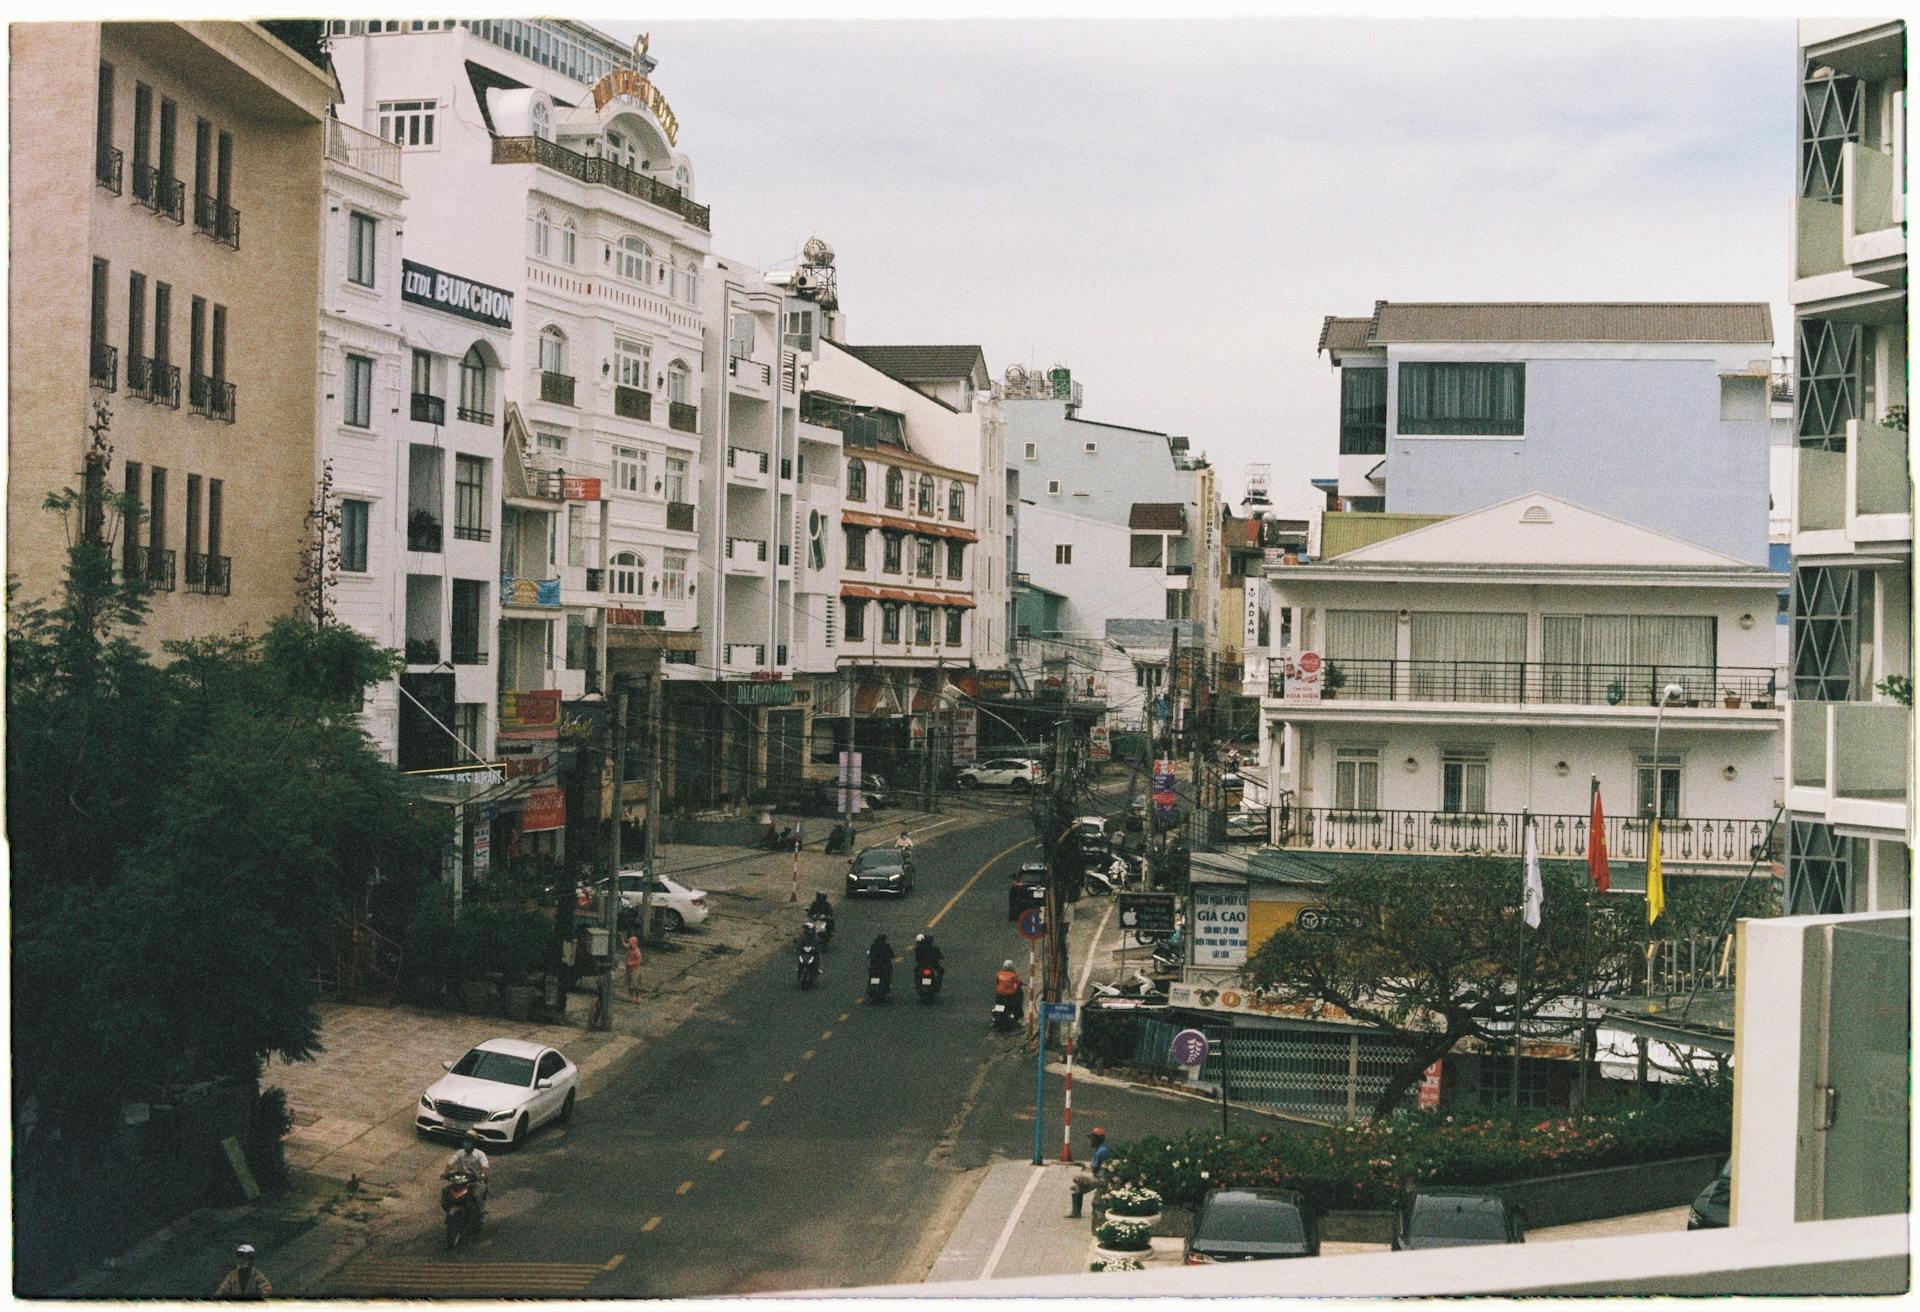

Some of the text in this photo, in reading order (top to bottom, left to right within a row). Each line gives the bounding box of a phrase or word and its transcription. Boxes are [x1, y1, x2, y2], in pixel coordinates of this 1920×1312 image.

[404, 270, 513, 322] LTDL BUKCHON
[1197, 908, 1247, 923] GIÁ CAO
